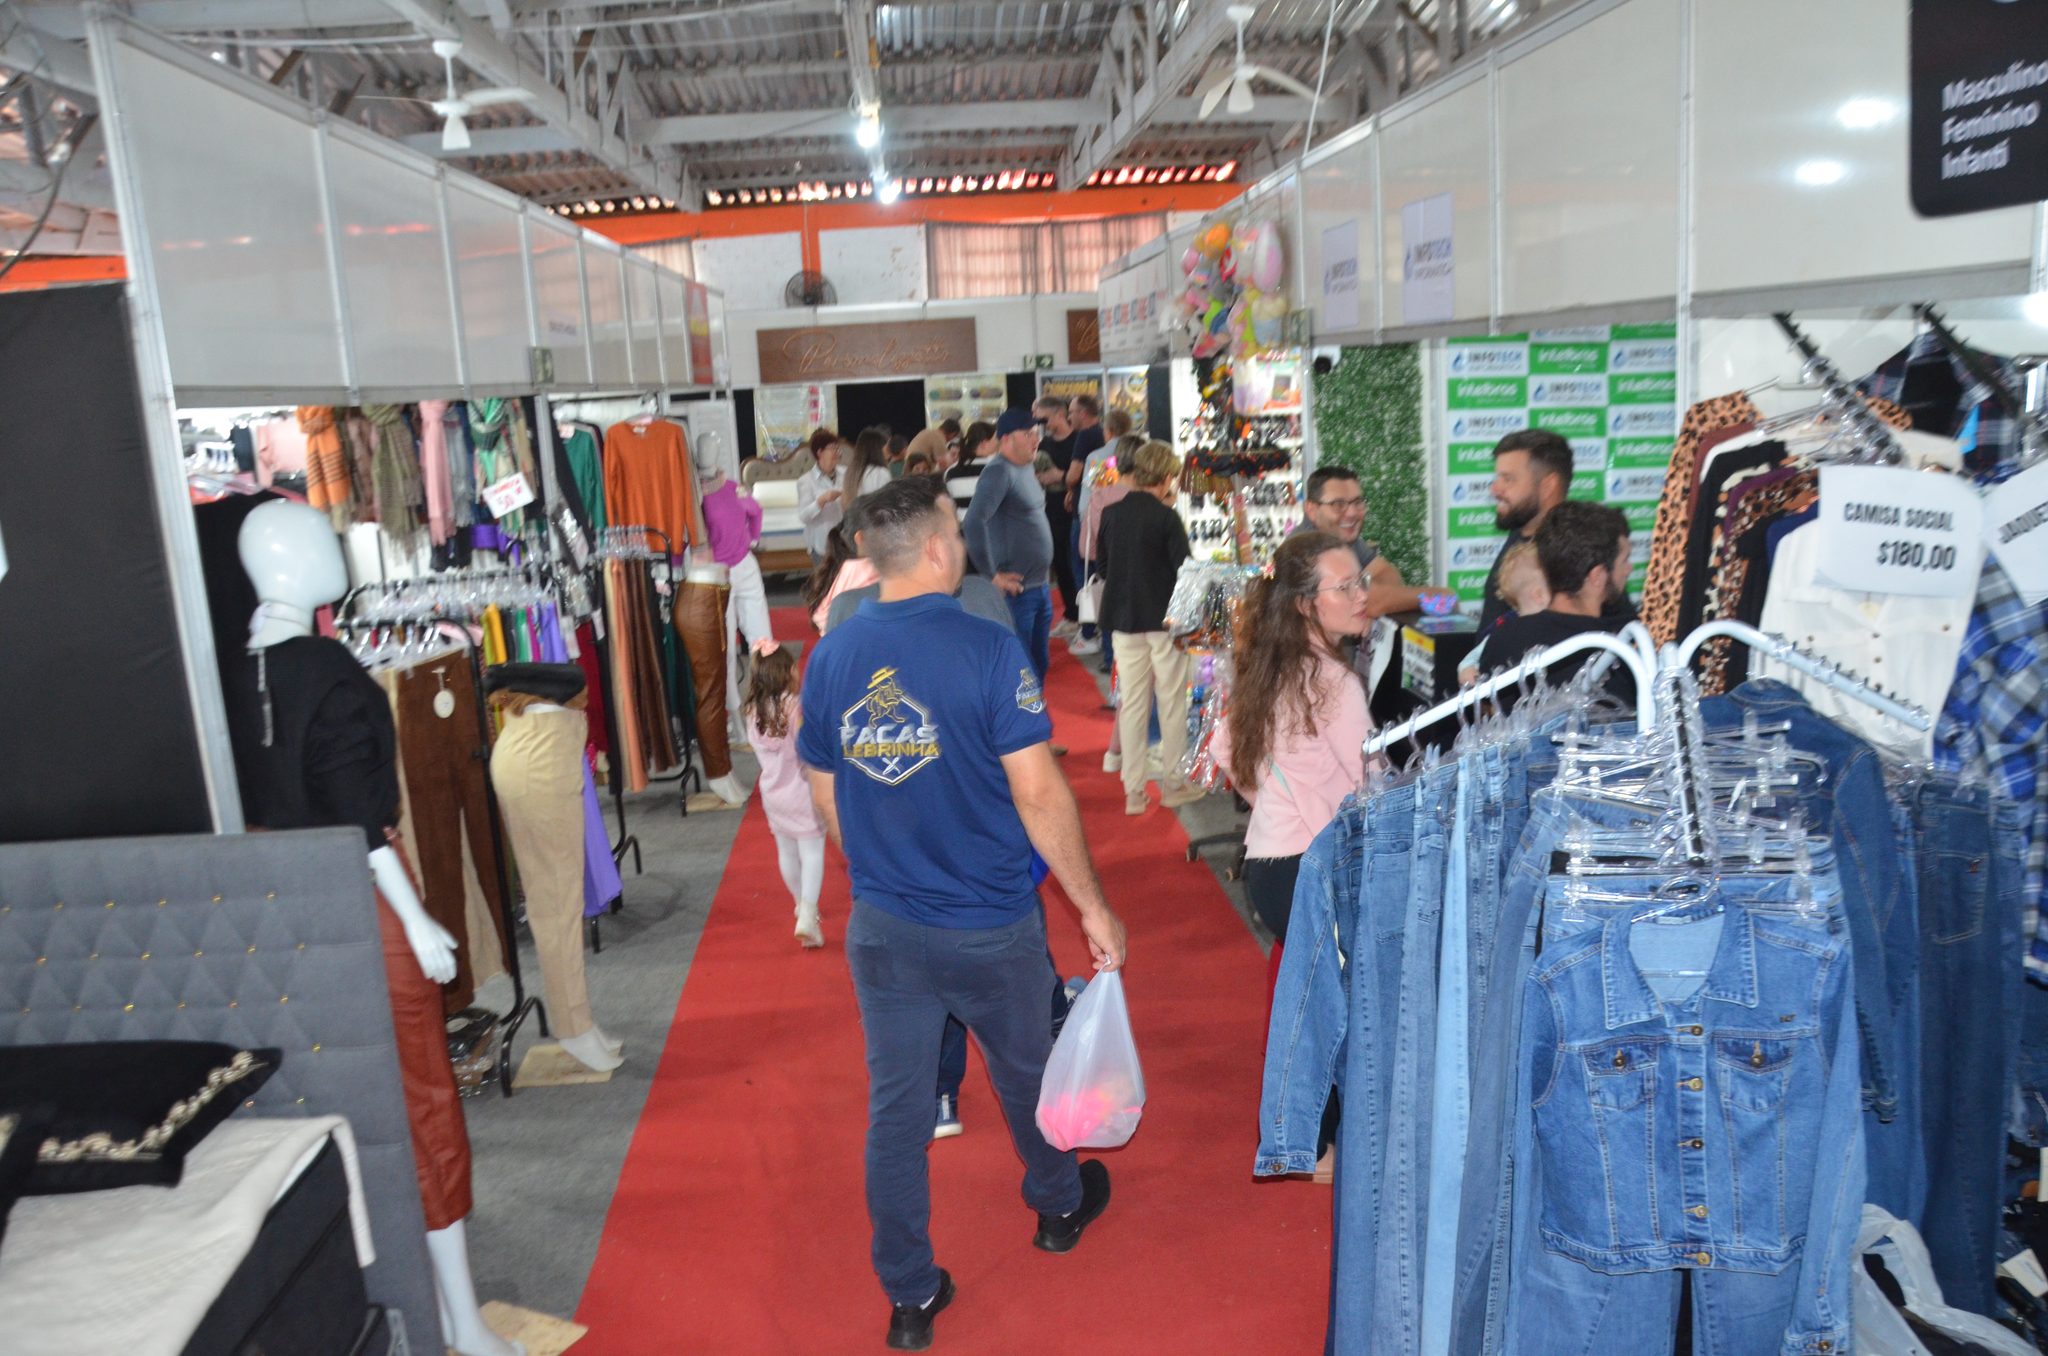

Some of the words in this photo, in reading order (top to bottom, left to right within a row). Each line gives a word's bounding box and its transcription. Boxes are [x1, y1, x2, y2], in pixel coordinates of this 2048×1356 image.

[1941, 59, 2048, 112] Masculino
[1941, 100, 2041, 147] Feminino
[1468, 416, 1523, 428] INFOTECH
[1843, 502, 1901, 526] CAMISA
[1905, 507, 1956, 532] SOCIAL
[1876, 539, 1958, 572] $180,00
[843, 742, 941, 758] LEBRINHA
